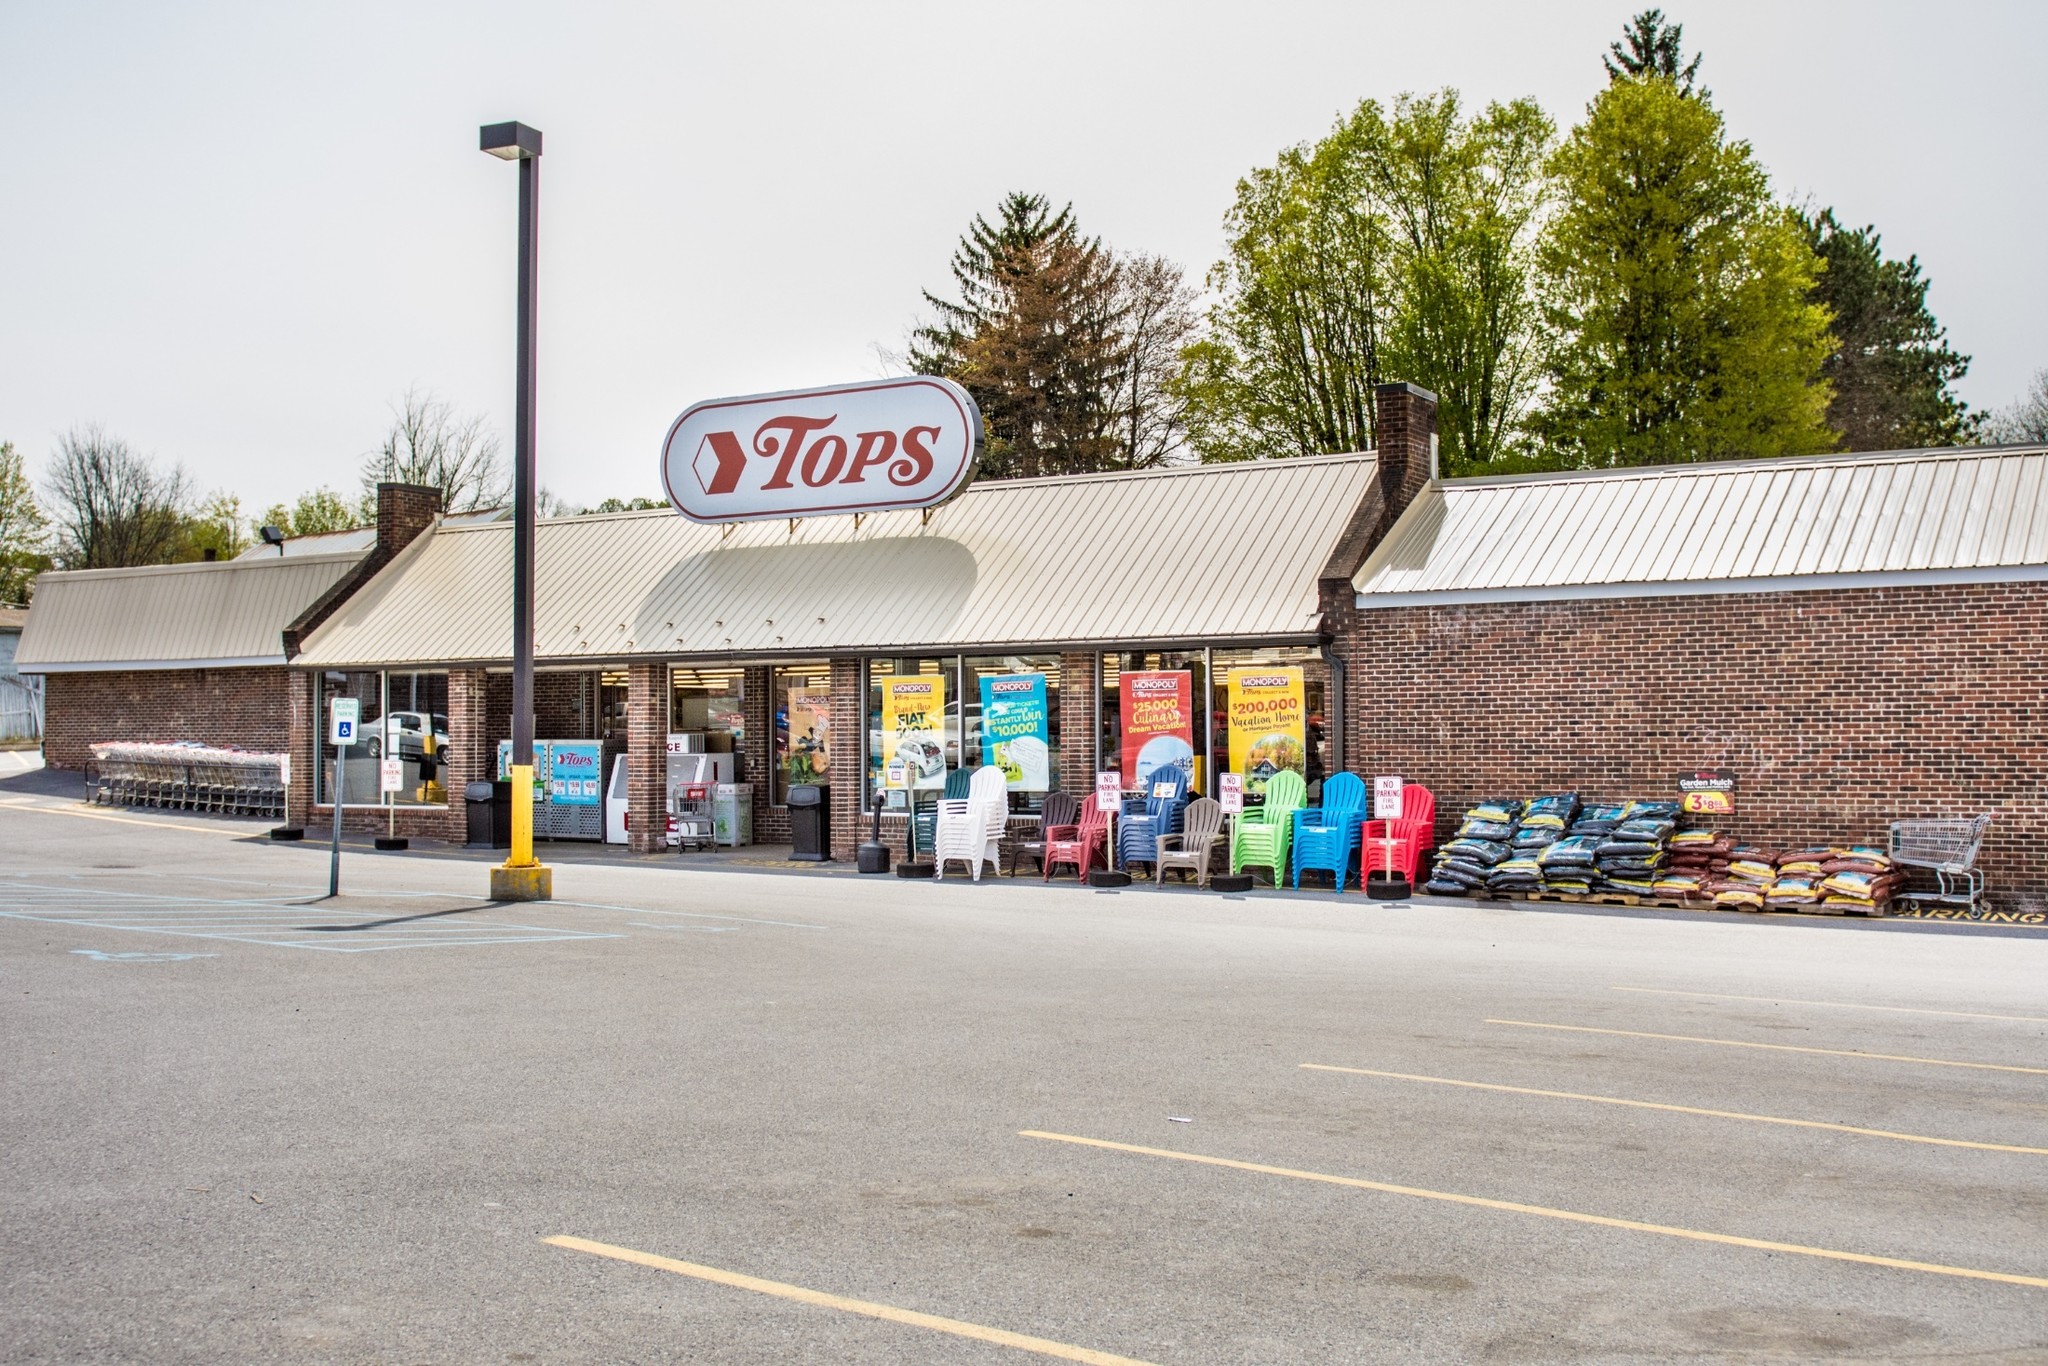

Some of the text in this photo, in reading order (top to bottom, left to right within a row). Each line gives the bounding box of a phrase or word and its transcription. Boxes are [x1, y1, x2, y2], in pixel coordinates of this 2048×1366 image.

[753, 413, 942, 491] TOPS
[992, 681, 1032, 692] MONOPOLY
[1133, 680, 1177, 689] MONOPOLY
[1242, 677, 1288, 686] MONOPOLY
[893, 684, 931, 692] MONOPOLY
[1133, 699, 1178, 712] $25,000
[1232, 697, 1298, 715] $200,000
[898, 711, 926, 726] FIAT
[1133, 710, 1181, 726] Culinary
[1231, 711, 1300, 728] Vacation Home
[991, 721, 1039, 738] $10,000!
[1128, 725, 1152, 734] Dream
[666, 743, 680, 752] CE
[566, 752, 594, 766] TOPS
[1098, 783, 1120, 791] PARKING
[1710, 778, 1733, 786] Mulch
[1221, 785, 1242, 793] PARKING
[1691, 794, 1703, 811] 3
